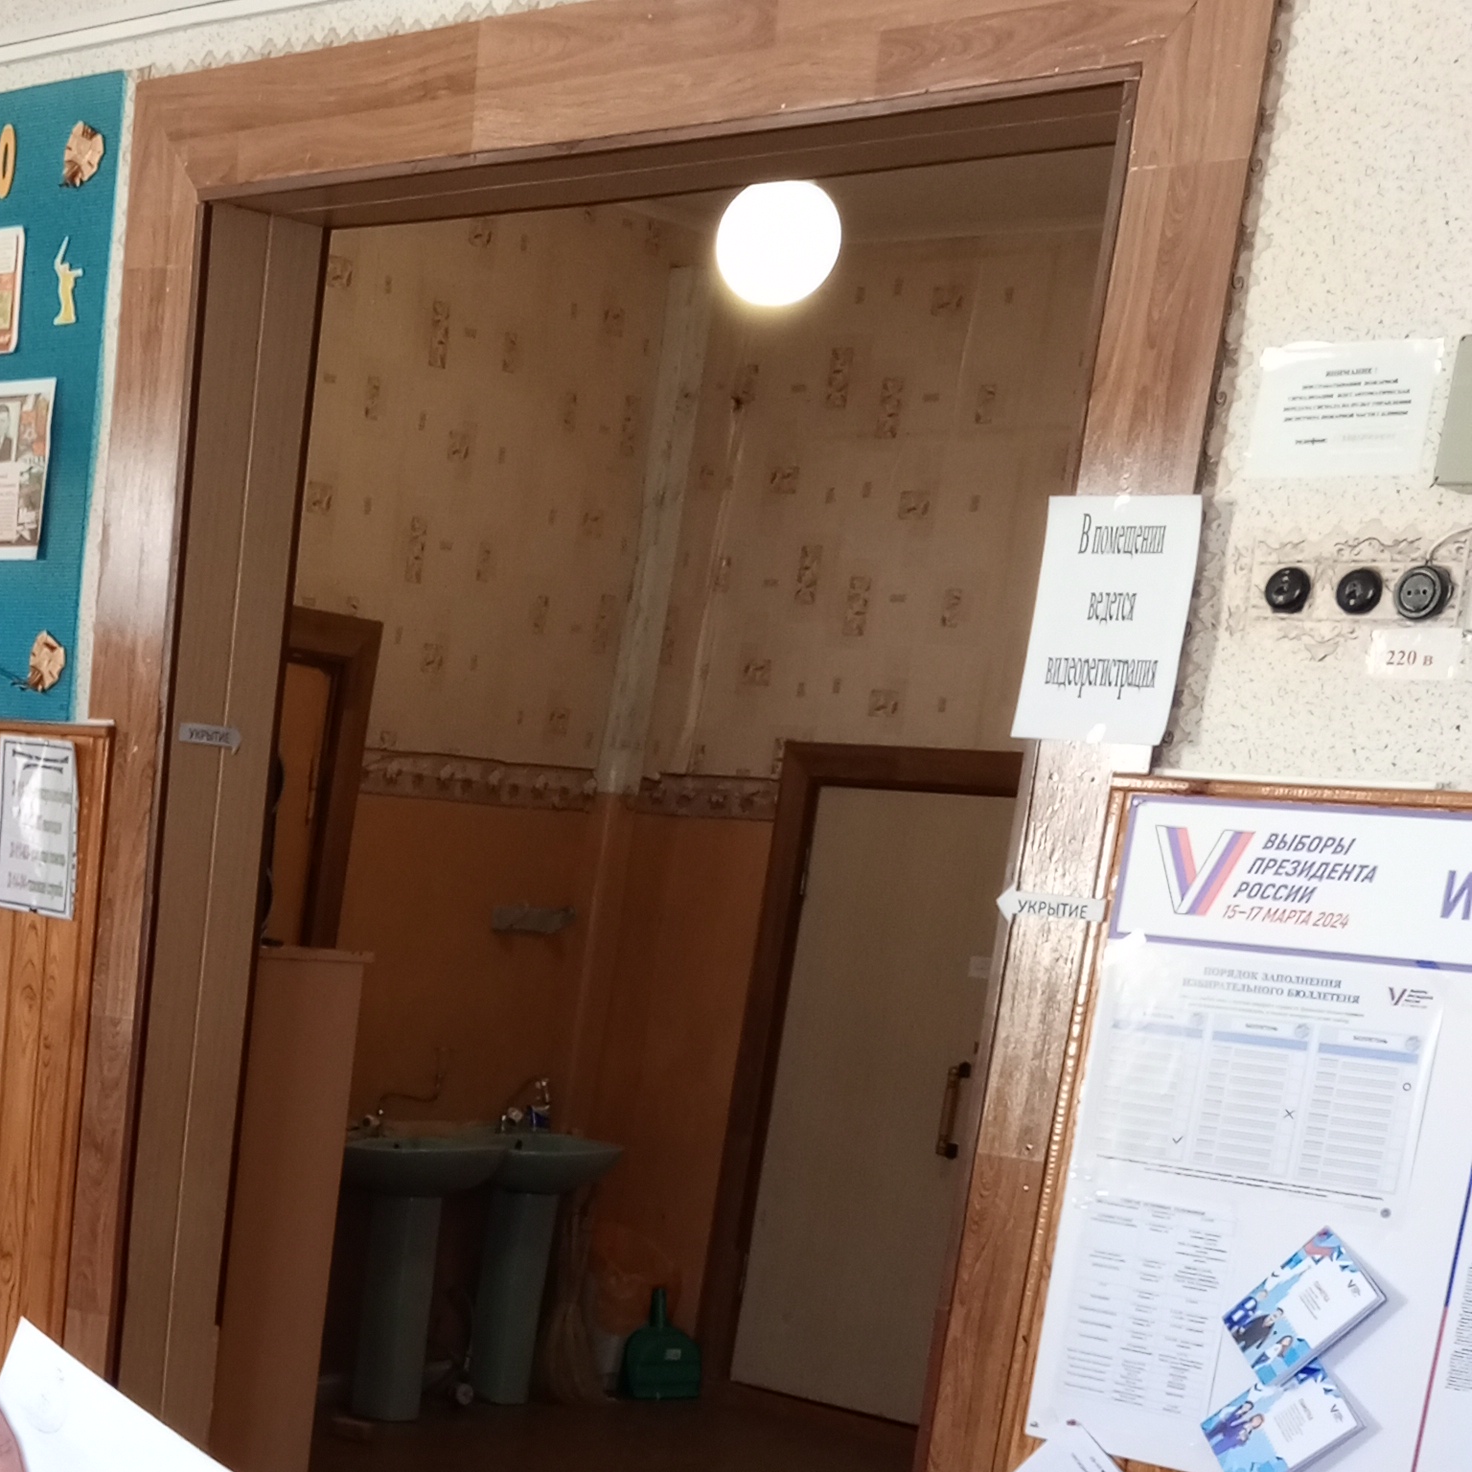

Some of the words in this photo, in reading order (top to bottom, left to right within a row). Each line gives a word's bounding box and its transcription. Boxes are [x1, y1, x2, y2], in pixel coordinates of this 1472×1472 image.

[1077, 512, 1092, 555] В
[1091, 523, 1167, 556] помещении
[1086, 590, 1138, 624] ведется
[1385, 649, 1417, 667] 220
[1044, 655, 1159, 700] видеорегистрация
[1261, 832, 1358, 856] ВЫБОРЫ
[1246, 856, 1379, 885] ПРЕЗИДЕНТА
[1232, 880, 1318, 905] РОССИИ
[1017, 898, 1089, 921] УКРЫТИЕ
[1260, 906, 1312, 927] МАРТА
[1312, 910, 1351, 930] 2024
[1203, 966, 1259, 981] ПОРЯДОК
[1260, 972, 1343, 990] ЗАПОЛНЕНИЯ
[1181, 977, 1284, 997] ИЗБИРАТЕЛЬНОГО
[1286, 986, 1361, 1005] БЮЛЛЕТЕНЯ
